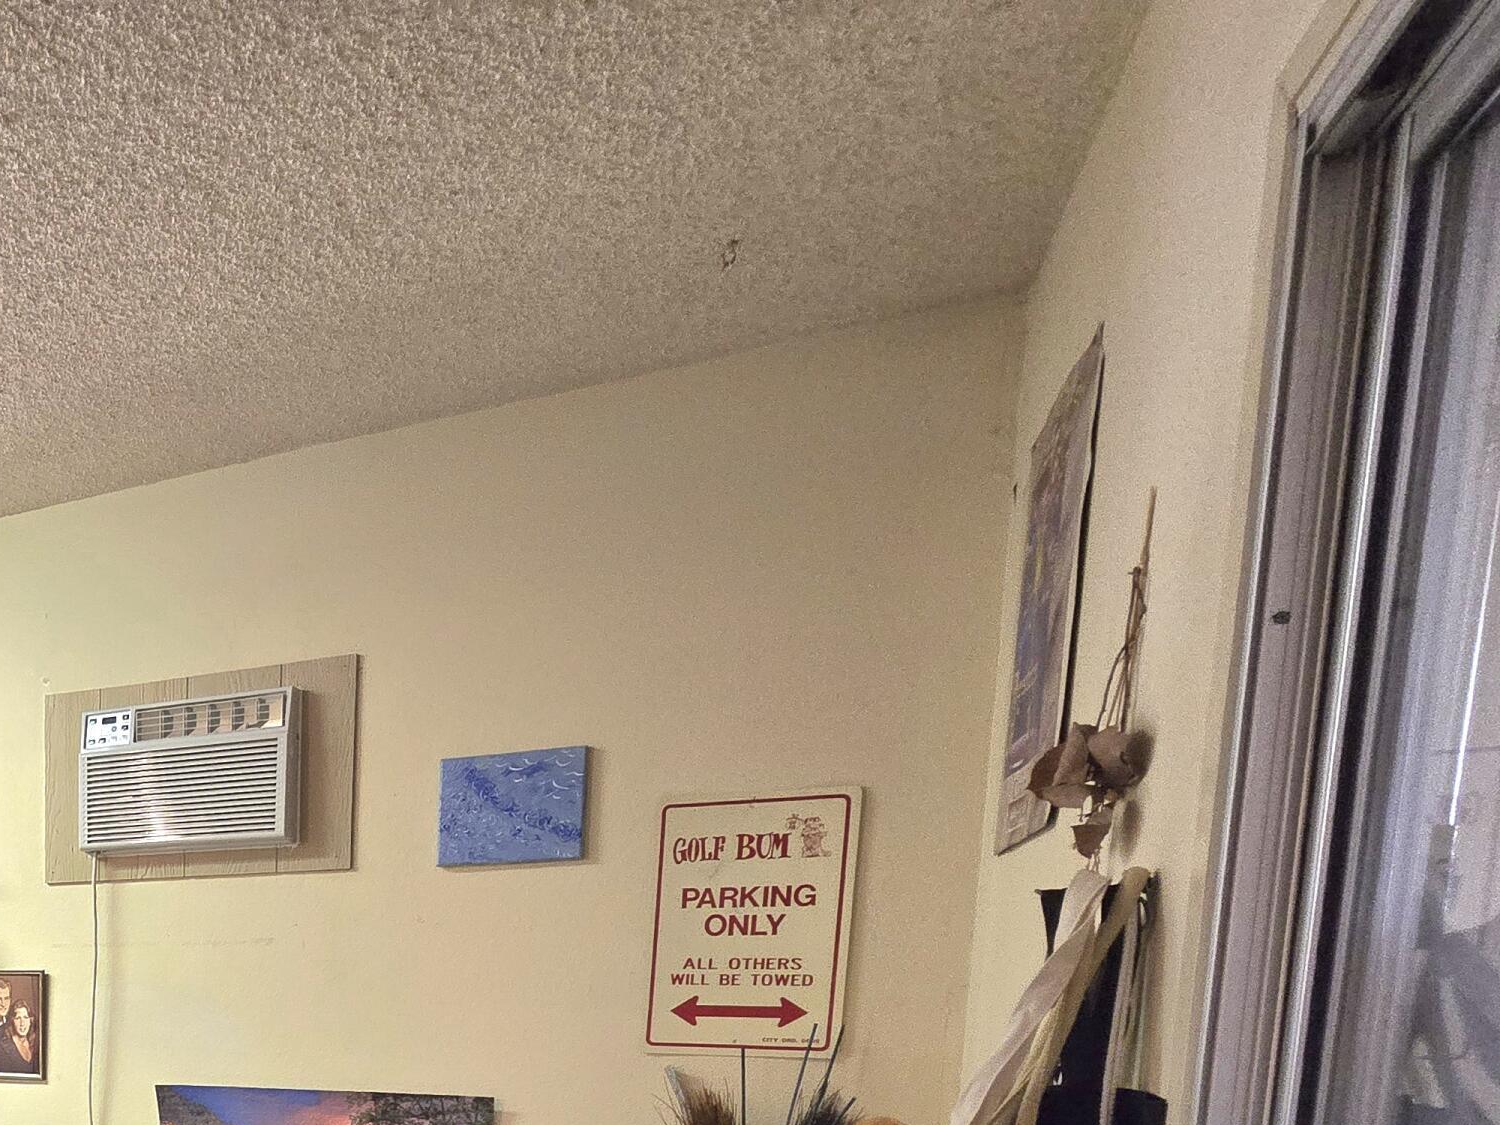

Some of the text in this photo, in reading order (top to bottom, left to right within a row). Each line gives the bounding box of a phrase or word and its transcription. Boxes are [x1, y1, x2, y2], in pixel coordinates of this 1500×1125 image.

[672, 831, 792, 865] GOLF BUM
[681, 884, 817, 909] PARKING
[704, 913, 787, 937] ONLY
[682, 957, 803, 970] ALL OTHERS
[670, 973, 814, 987] WILL BE TOWED
